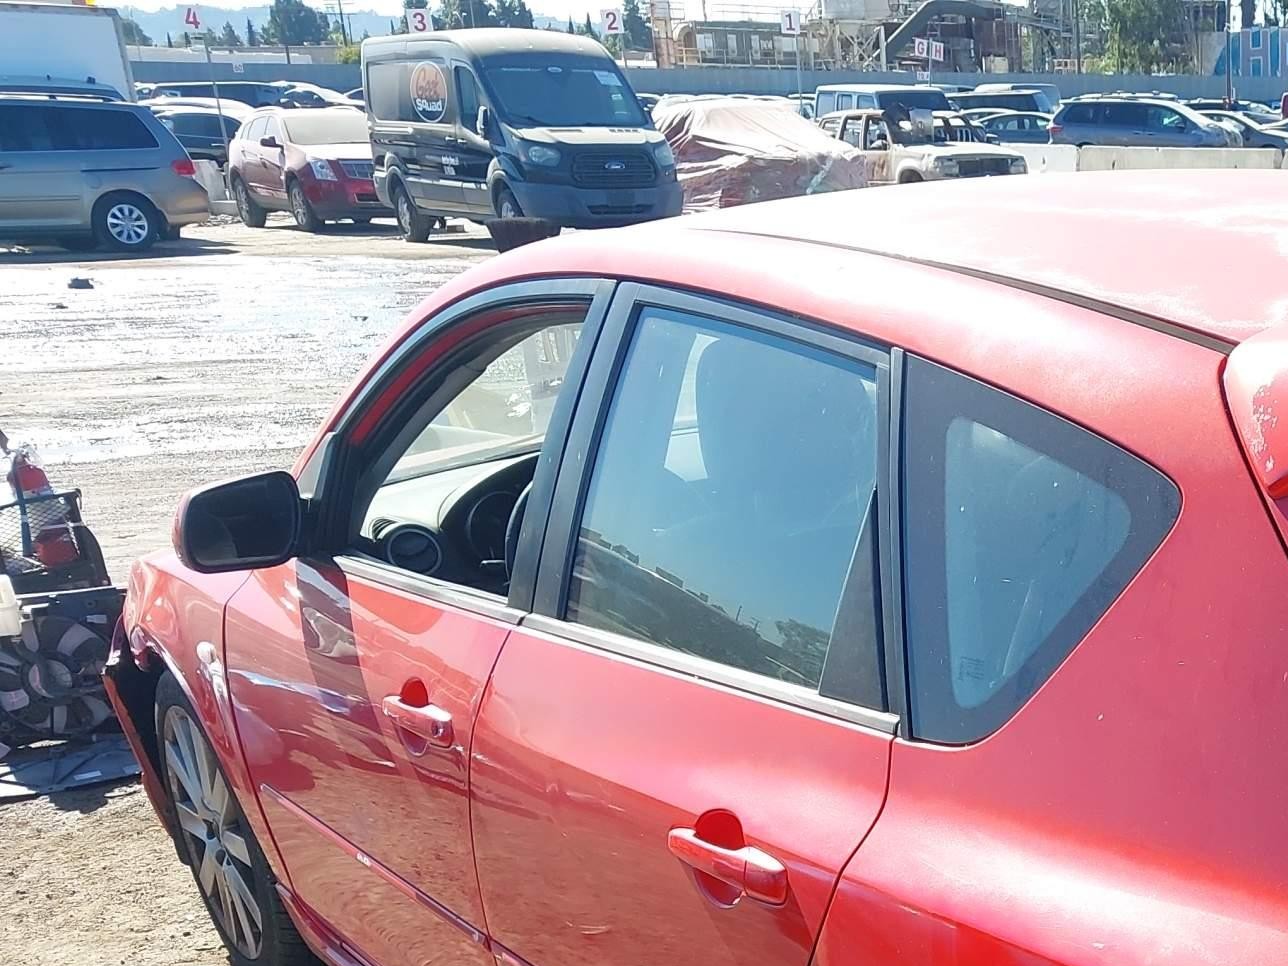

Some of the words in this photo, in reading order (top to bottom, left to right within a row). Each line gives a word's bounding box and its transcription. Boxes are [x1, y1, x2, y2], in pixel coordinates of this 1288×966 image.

[185, 8, 200, 29] 4
[413, 12, 426, 32] 3
[606, 12, 618, 30] 2
[785, 13, 796, 31] 1
[917, 41, 925, 55] G
[934, 43, 942, 60] H
